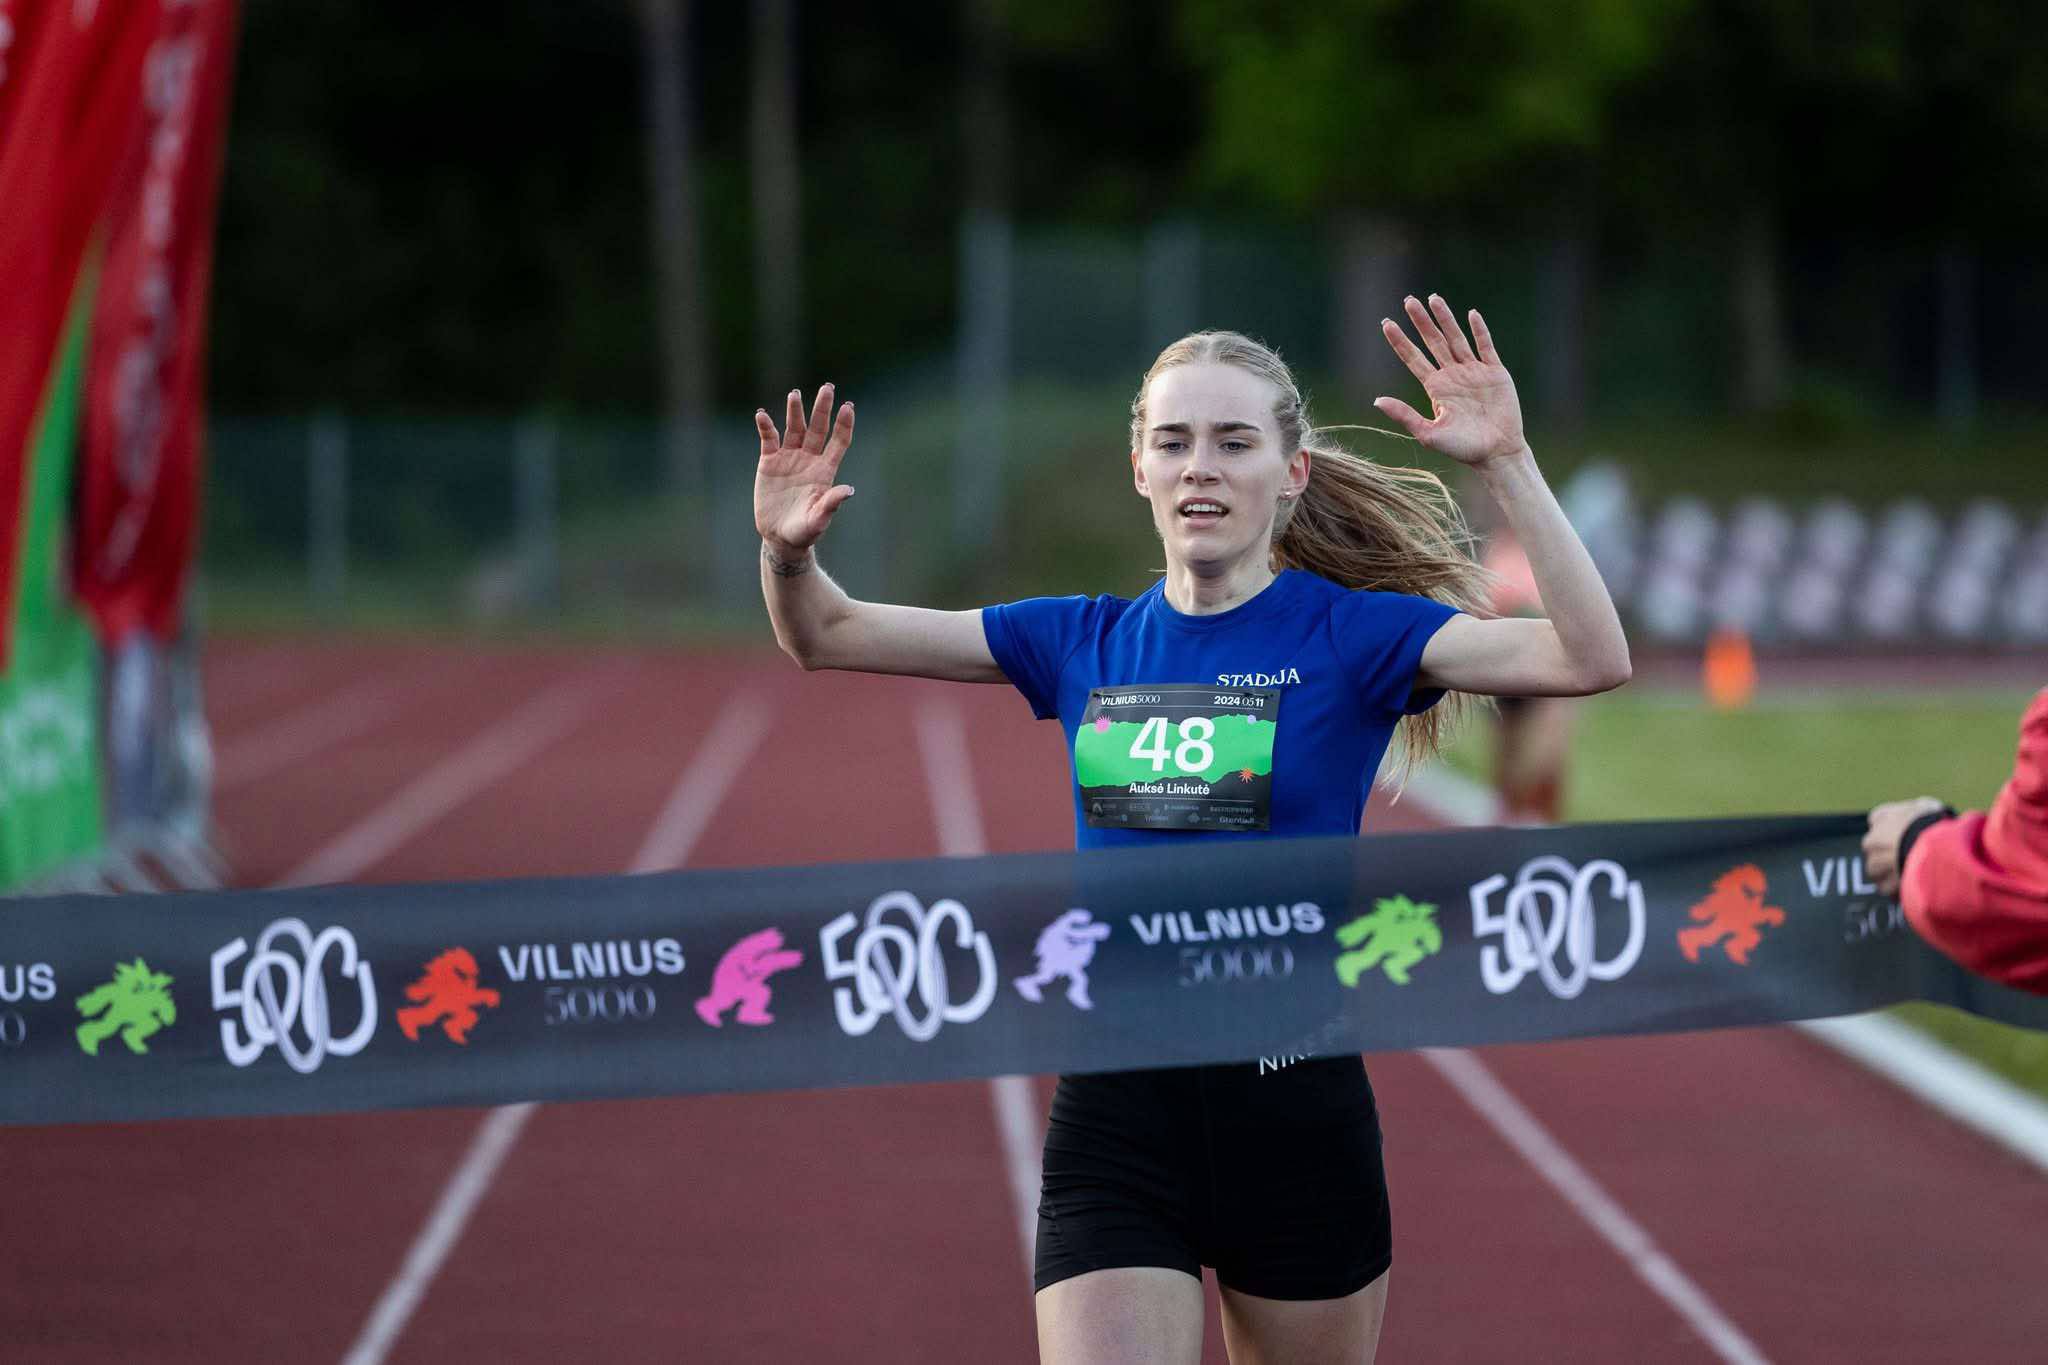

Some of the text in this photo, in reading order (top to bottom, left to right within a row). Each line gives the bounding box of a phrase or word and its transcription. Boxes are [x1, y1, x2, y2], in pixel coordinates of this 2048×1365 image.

[1216, 668, 1301, 688] STADIJA
[1213, 695, 1241, 706] 2024
[1129, 716, 1215, 773] 48
[1129, 782, 1210, 795] Auksė Linkutė
[1129, 901, 1326, 945] VILNIUS
[498, 937, 686, 982] VILNIUS
[1179, 943, 1295, 988] 5000
[544, 982, 657, 1025] 5000
